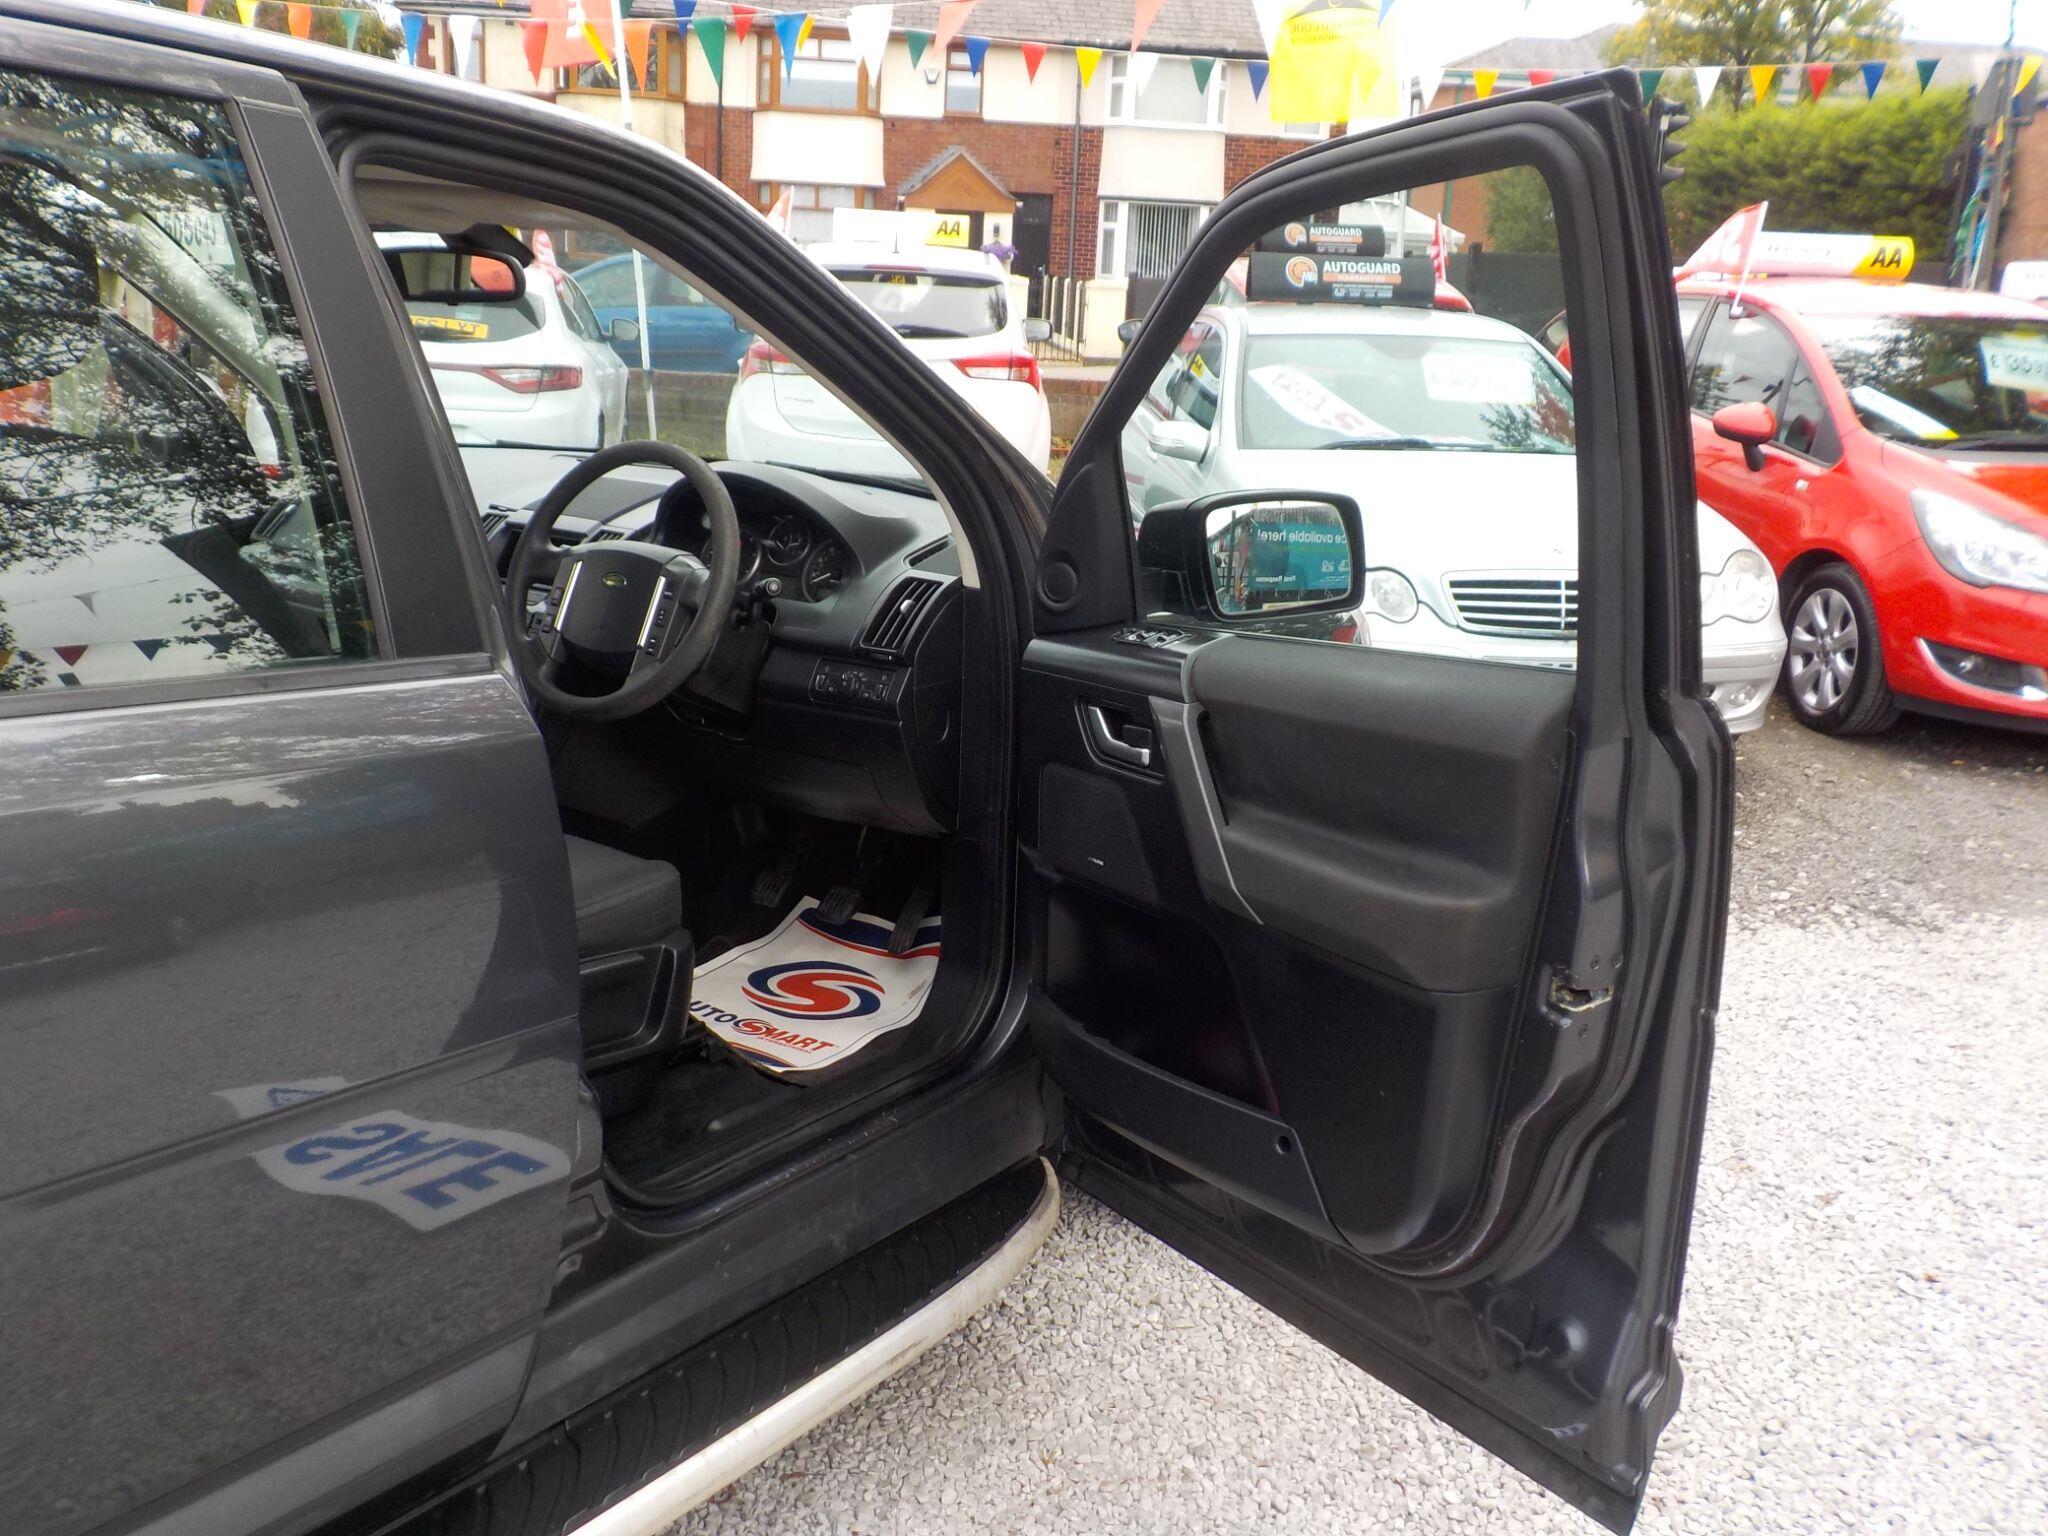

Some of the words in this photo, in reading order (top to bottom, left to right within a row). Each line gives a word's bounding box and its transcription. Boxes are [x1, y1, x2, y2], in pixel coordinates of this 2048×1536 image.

[936, 220, 961, 236] AA
[1309, 226, 1363, 237] AUTOGUARD
[1869, 246, 1903, 269] AA
[1323, 261, 1401, 274] AUTOGUARD
[689, 1000, 835, 1051] UTOSMART
